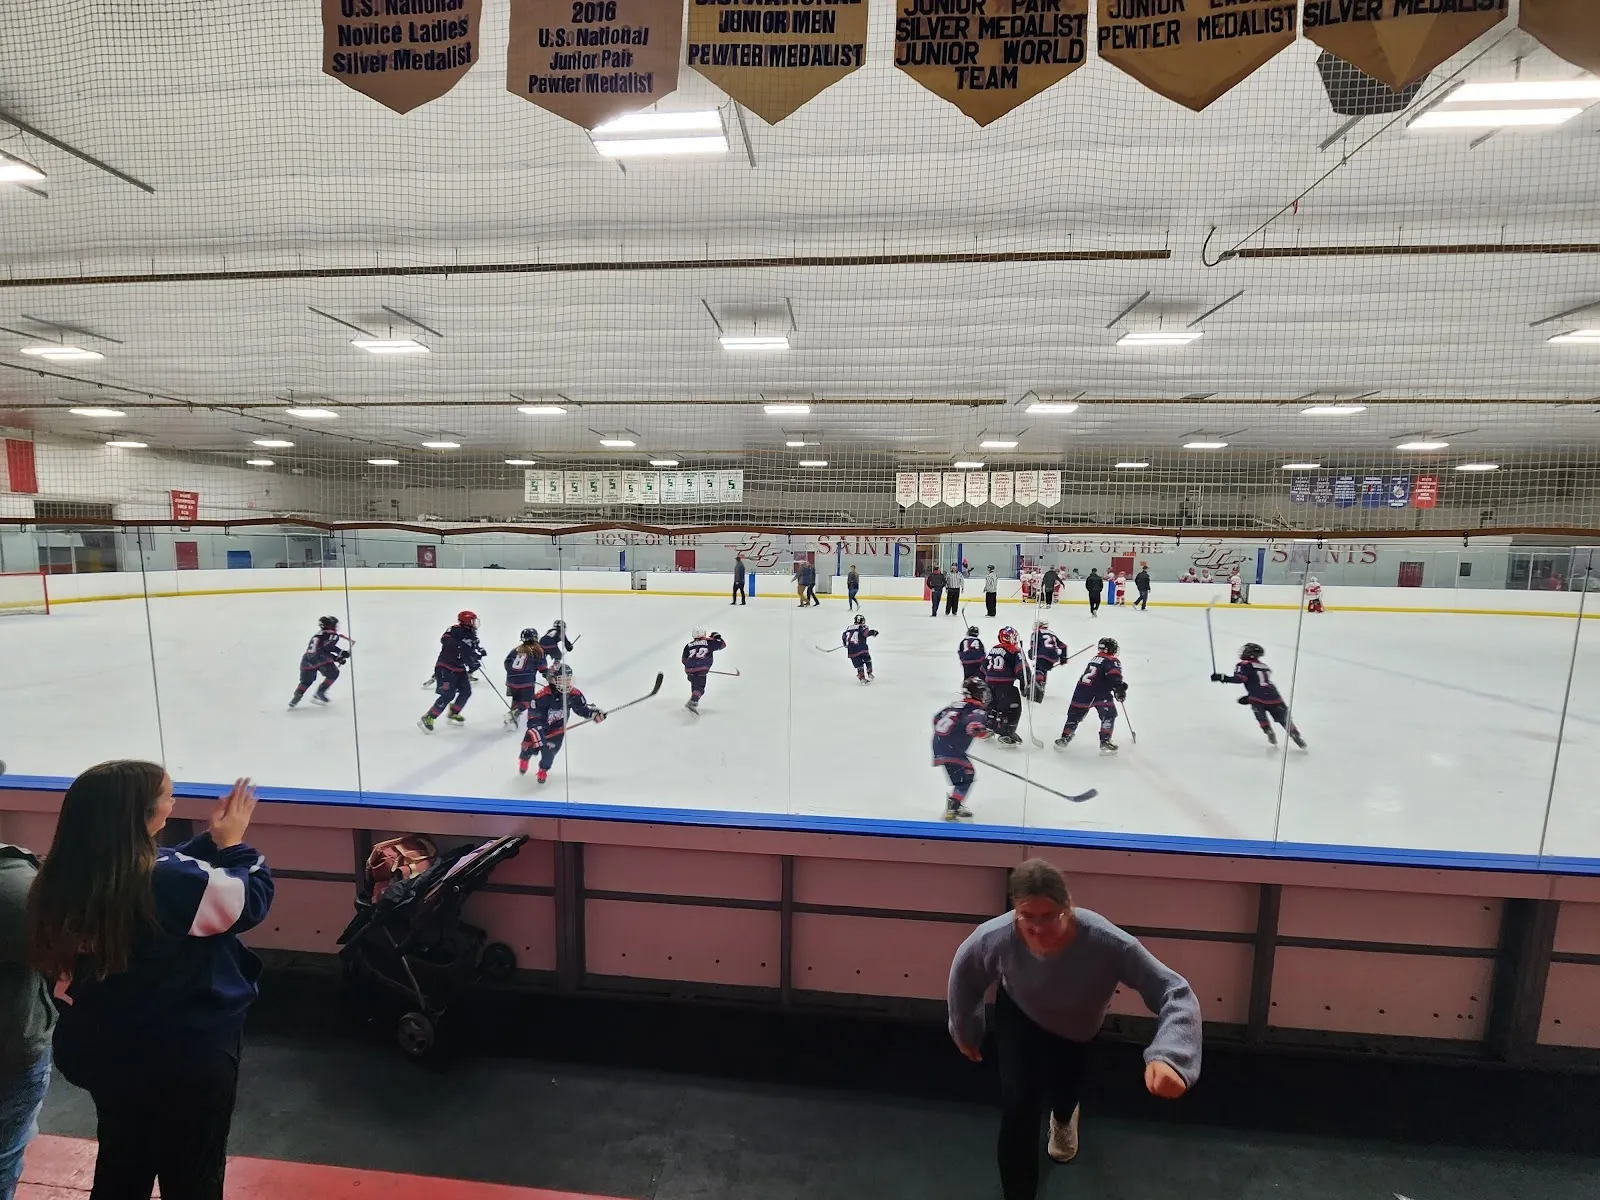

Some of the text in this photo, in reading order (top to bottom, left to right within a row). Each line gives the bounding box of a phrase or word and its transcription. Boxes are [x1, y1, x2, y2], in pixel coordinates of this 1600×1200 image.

[342, 0, 379, 17] U.S.
[572, 1, 617, 23] 2016
[904, 0, 1061, 16] JUNIOR PAIR
[1109, 0, 1186, 19] JUNIOR
[1303, 0, 1382, 27] SILVER
[338, 18, 469, 47] Novice Ladies
[719, 10, 836, 33] JUNIOR MEN
[896, 13, 1088, 42] SILVER MEDALIST
[1098, 5, 1297, 51] PEWTER MEDALIST
[538, 26, 649, 48] U.S. National
[332, 42, 472, 74] Silver Medalist
[550, 49, 634, 70] Junior Pair
[688, 44, 864, 67] PEWTER MEDALIST
[896, 39, 1085, 65] JUNIOR WORLD
[528, 72, 654, 94] Pewter Medalist
[955, 65, 1019, 90] TEAM
[596, 532, 640, 546] HOME
[817, 535, 912, 557] SAINTS
[1044, 540, 1164, 554] OME OF THE
